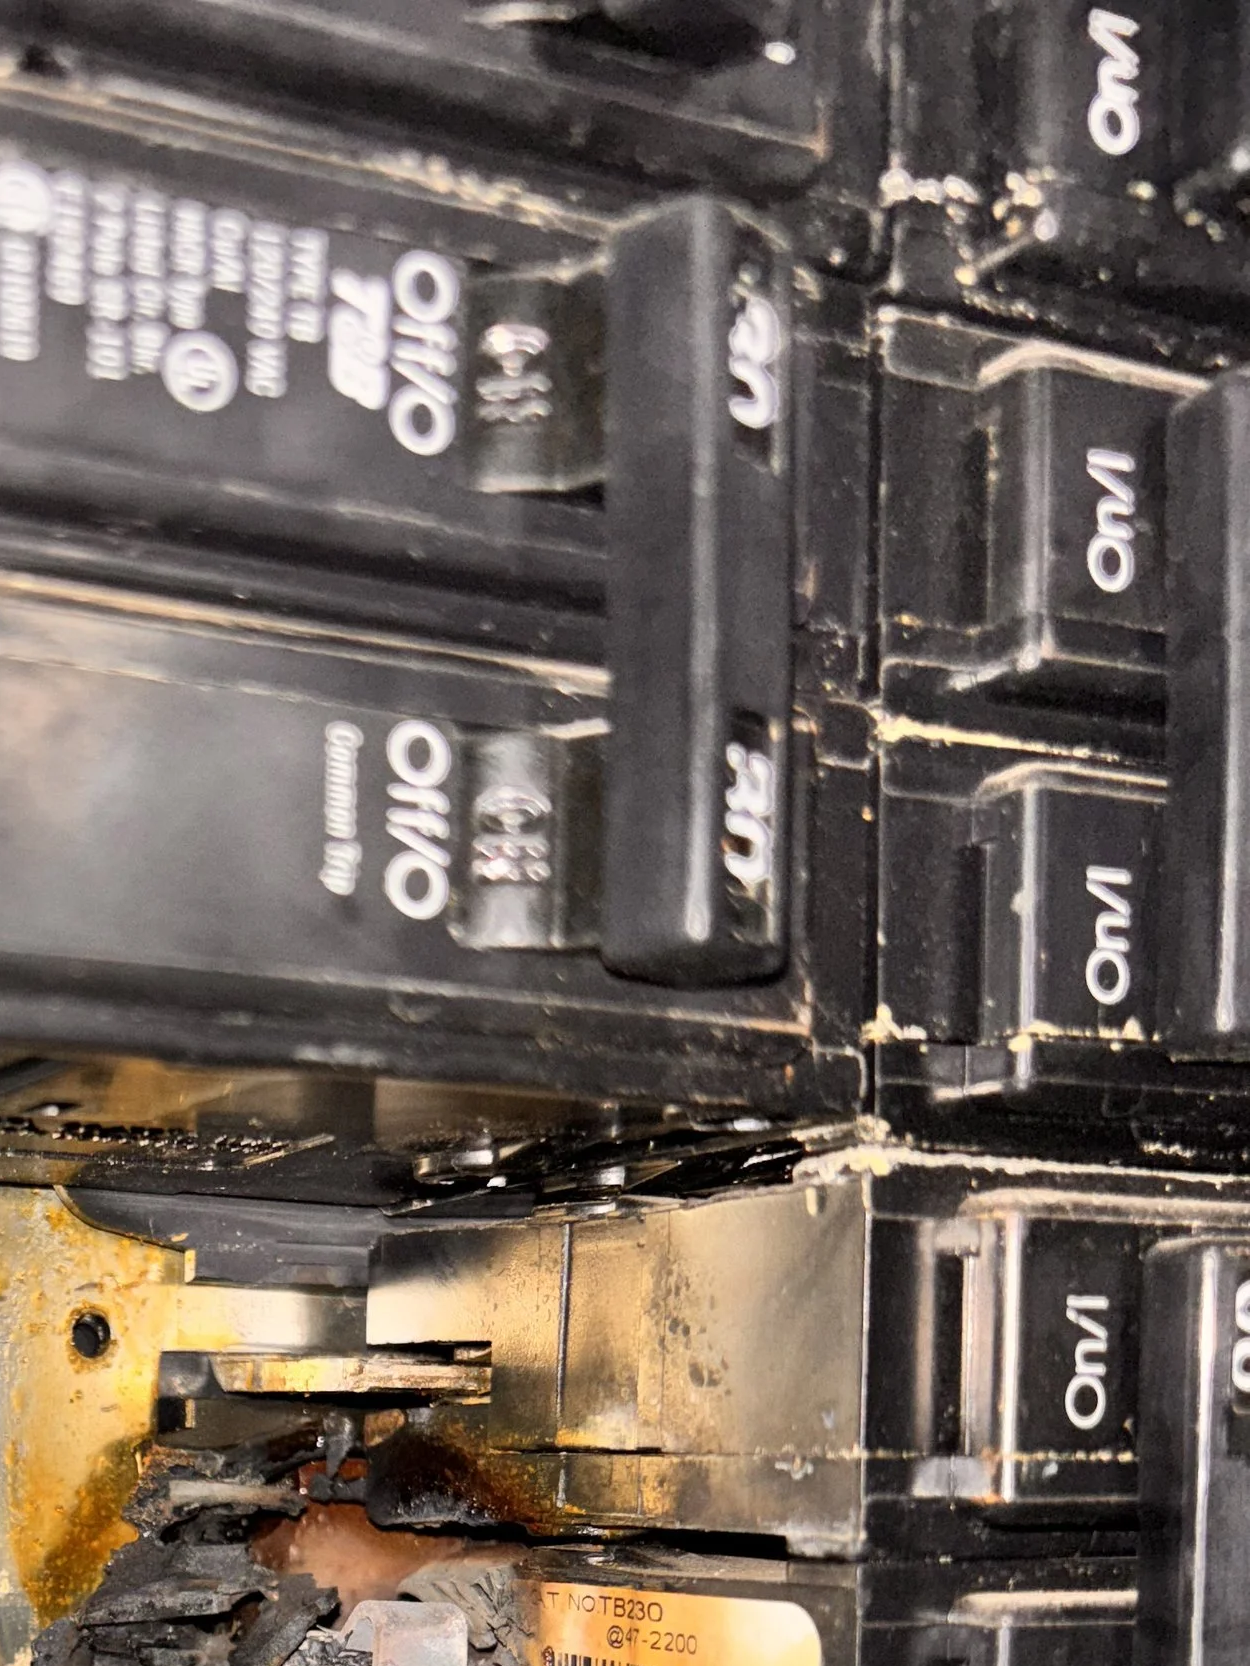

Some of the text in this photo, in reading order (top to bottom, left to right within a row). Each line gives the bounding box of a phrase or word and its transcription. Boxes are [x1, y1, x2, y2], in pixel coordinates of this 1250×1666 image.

[245, 222, 287, 398] 120/240 VAC
[388, 250, 460, 456] Off/O
[1086, 447, 1136, 593] On/I
[318, 721, 364, 896] Common Trip
[384, 720, 452, 920] Off/O
[1085, 865, 1131, 1005] On/I
[1064, 1294, 1110, 1430] On/I
